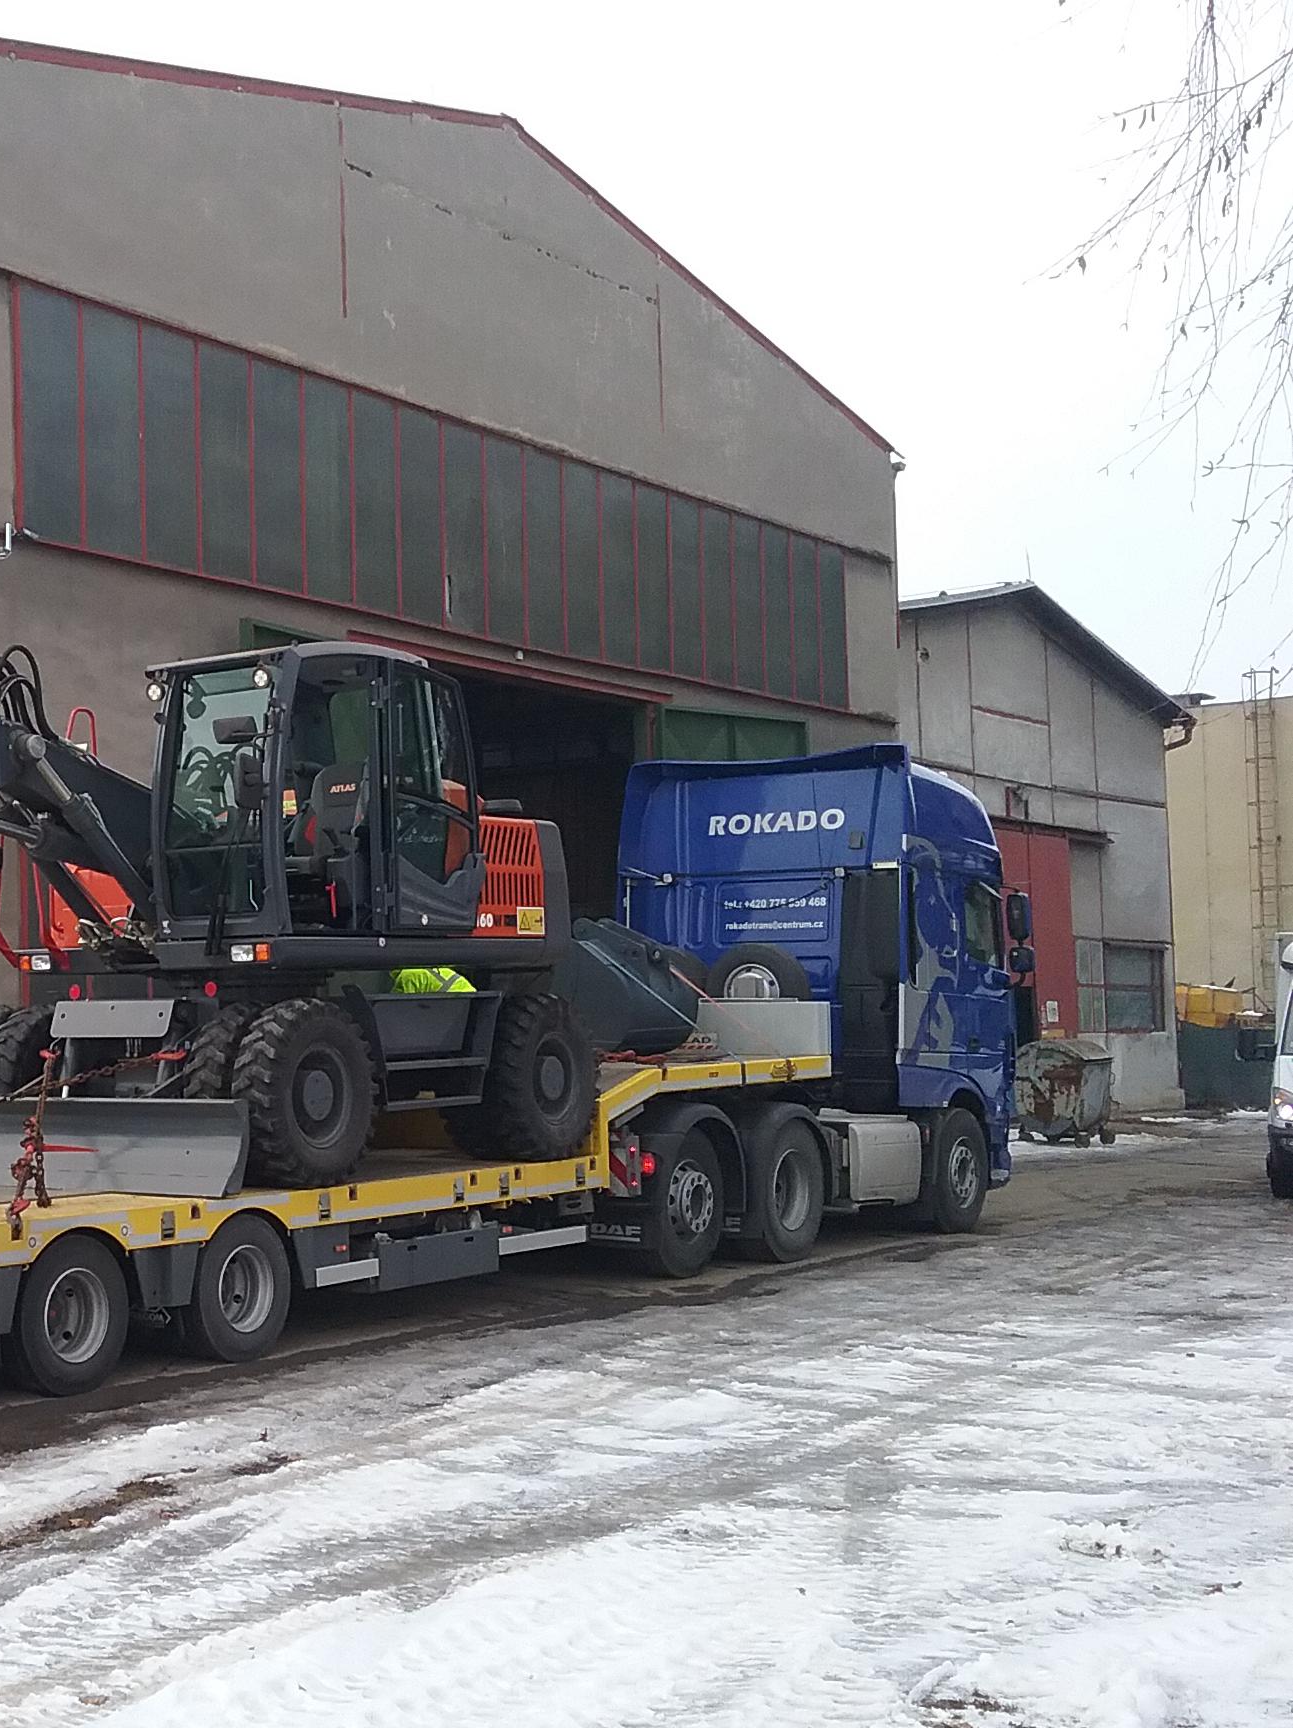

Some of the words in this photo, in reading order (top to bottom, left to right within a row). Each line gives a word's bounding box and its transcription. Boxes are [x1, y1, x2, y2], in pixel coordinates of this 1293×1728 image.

[329, 783, 356, 793] ATLAS
[708, 808, 845, 836] ROKADO
[744, 899, 767, 909] +420
[808, 896, 827, 907] 468
[725, 920, 824, 930] rokadotrans@centrum.cz
[590, 1222, 642, 1237] DAF
